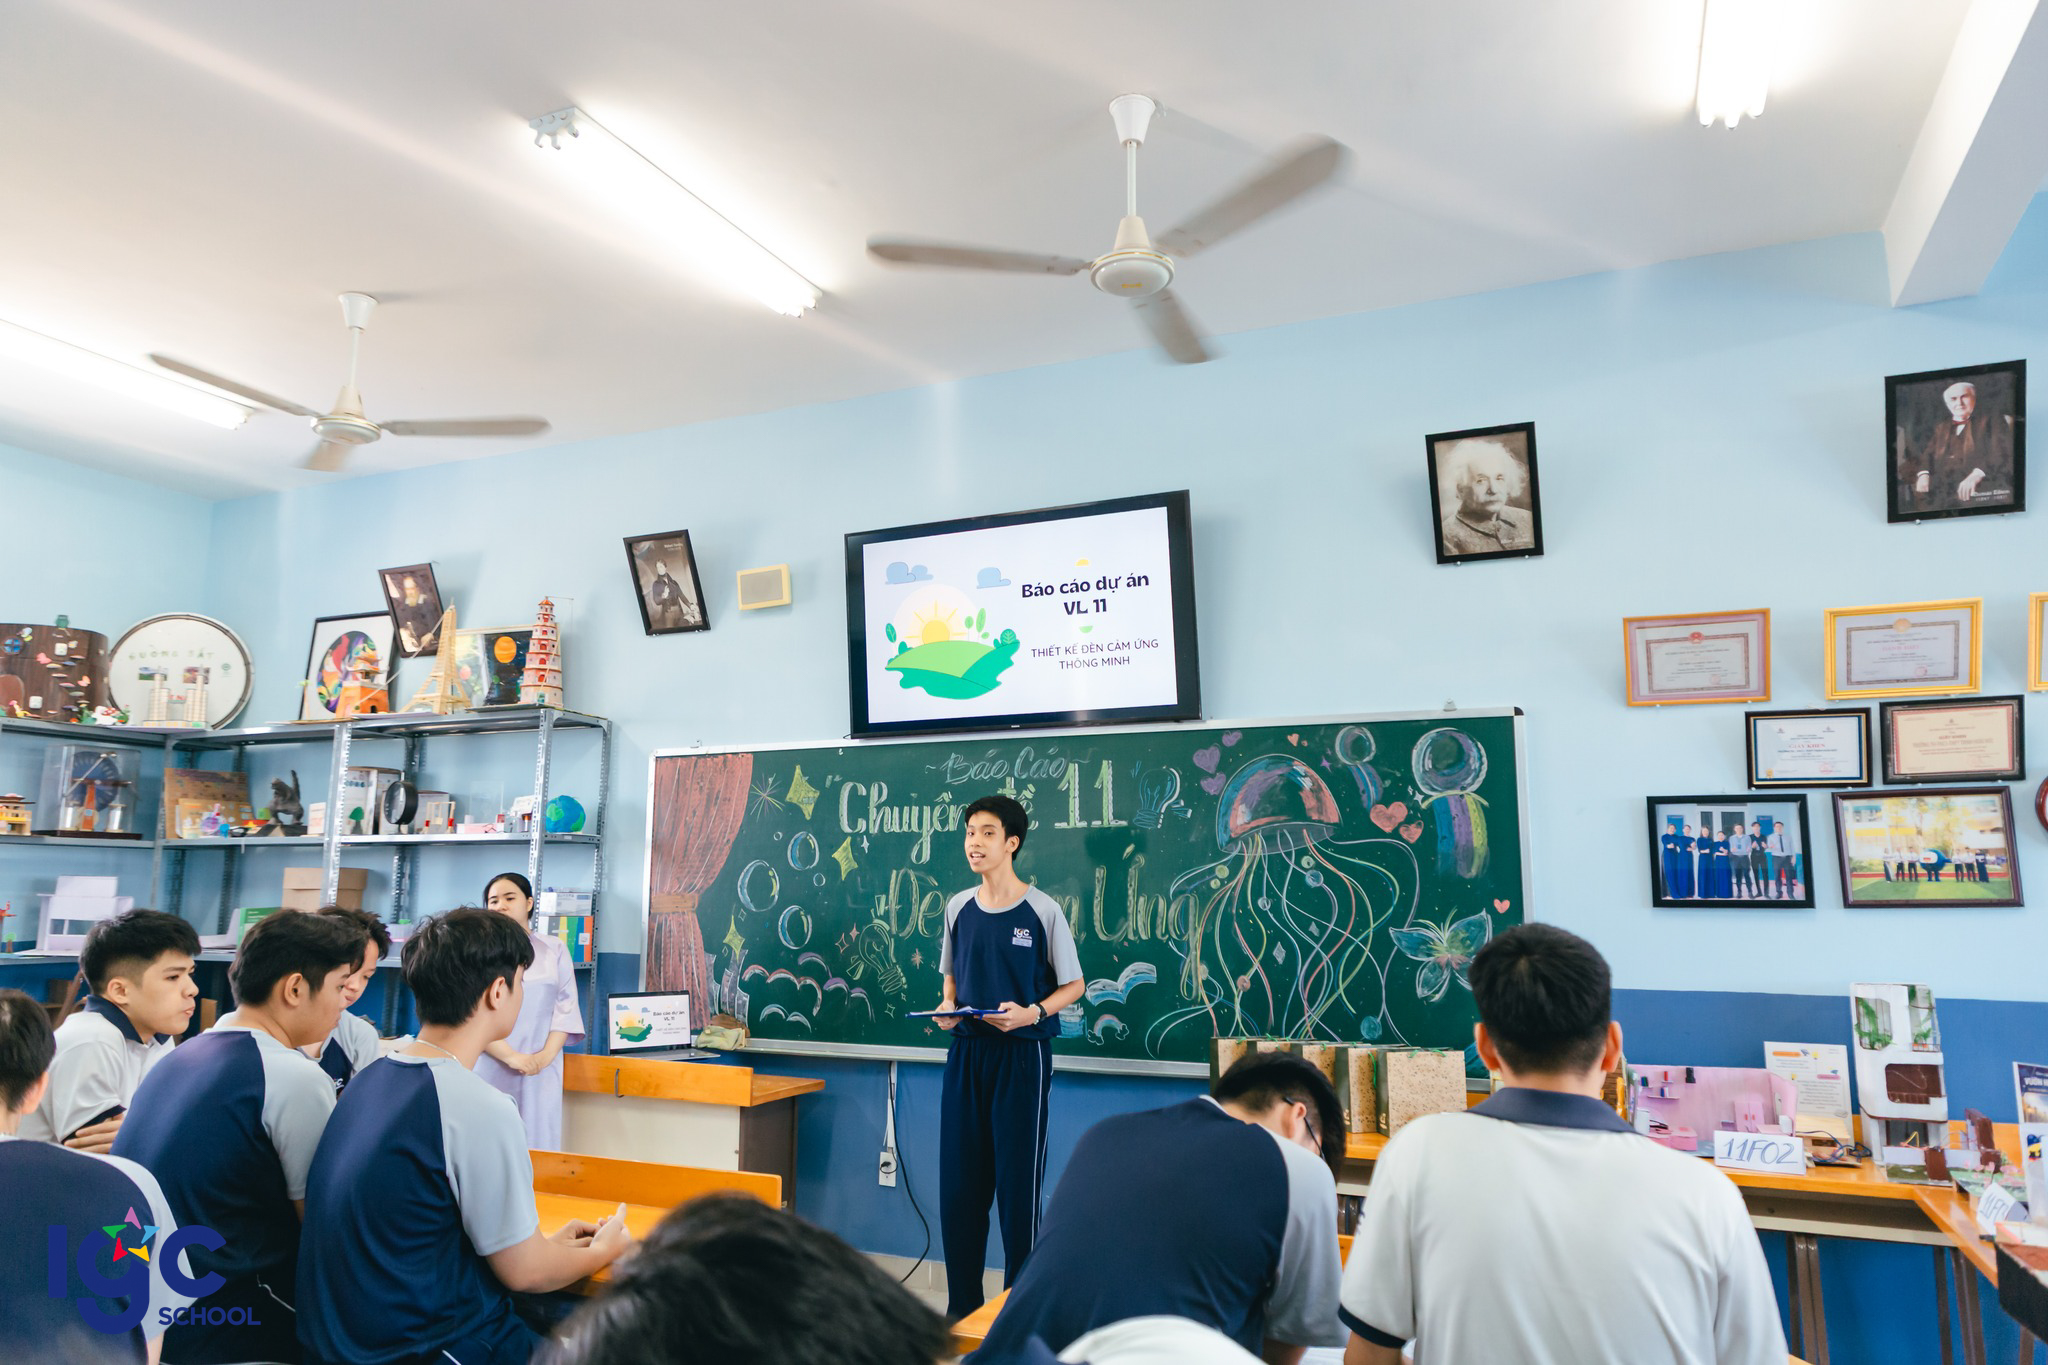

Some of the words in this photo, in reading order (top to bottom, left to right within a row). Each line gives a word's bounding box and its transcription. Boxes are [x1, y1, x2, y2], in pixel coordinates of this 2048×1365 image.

[1021, 582, 1055, 598] Báo
[1059, 579, 1091, 594] cáo
[1095, 576, 1122, 593] dự
[1126, 573, 1150, 588] án
[1063, 601, 1089, 616] VL
[1092, 598, 1107, 613] 11
[1031, 644, 1061, 658] THIẾT
[1064, 642, 1079, 655] KẾ
[1081, 641, 1104, 654] ĐÈN
[1107, 639, 1131, 652] CẢM
[1134, 638, 1159, 650] ỨNG
[1059, 657, 1099, 670] THÔNG
[1101, 656, 1131, 667] MINH
[940, 748, 1010, 785] Báo
[1013, 745, 1068, 779] Cáo
[1054, 759, 1129, 829] 11
[885, 867, 950, 939] Đè
[1093, 843, 1201, 1002] Ứng
[1718, 1138, 1799, 1165] 11F02
